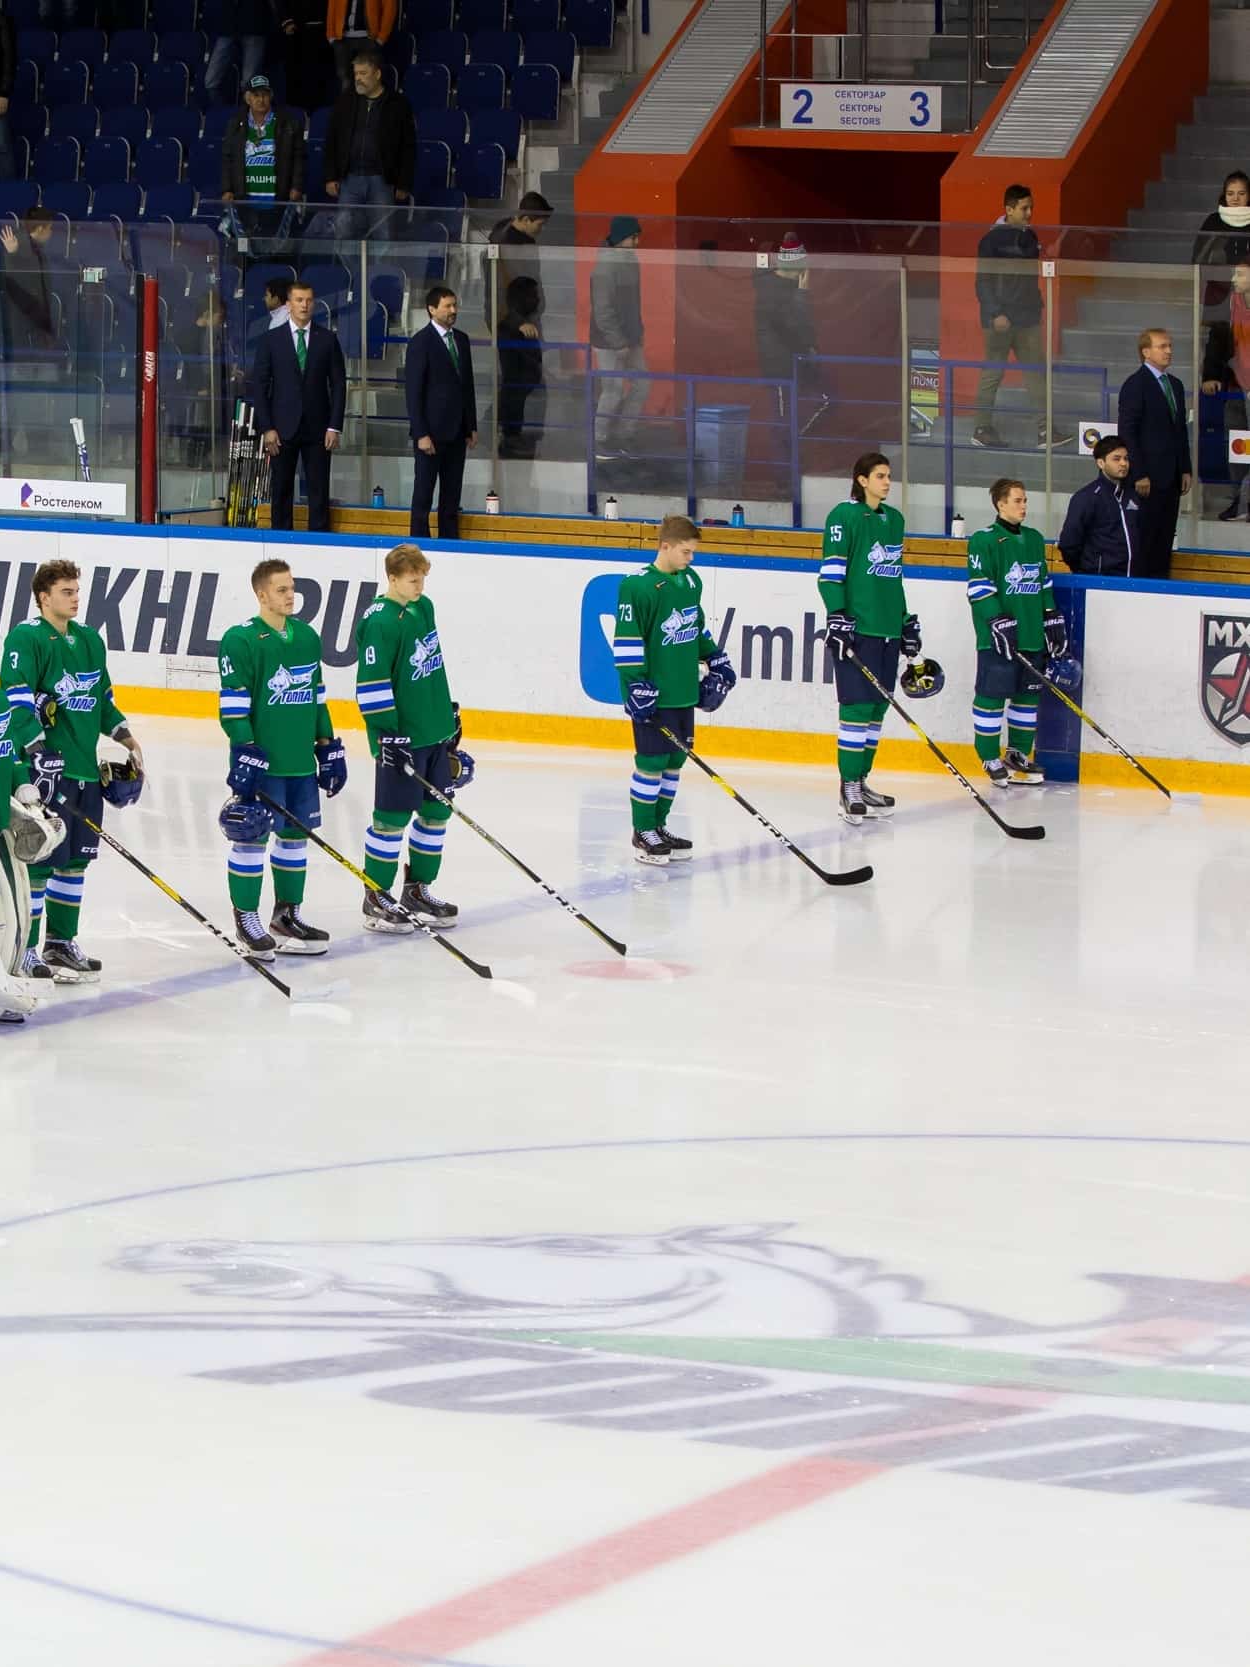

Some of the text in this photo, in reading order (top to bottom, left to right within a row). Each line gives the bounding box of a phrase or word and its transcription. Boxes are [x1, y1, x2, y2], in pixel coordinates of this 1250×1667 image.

[792, 89, 814, 124] 2
[839, 104, 882, 113] СЕКТОРЫ
[909, 91, 931, 127] 3
[840, 116, 882, 126] SECTORS
[34, 495, 102, 510] Ростелеком
[618, 604, 633, 622] 73
[9, 652, 19, 669] 3
